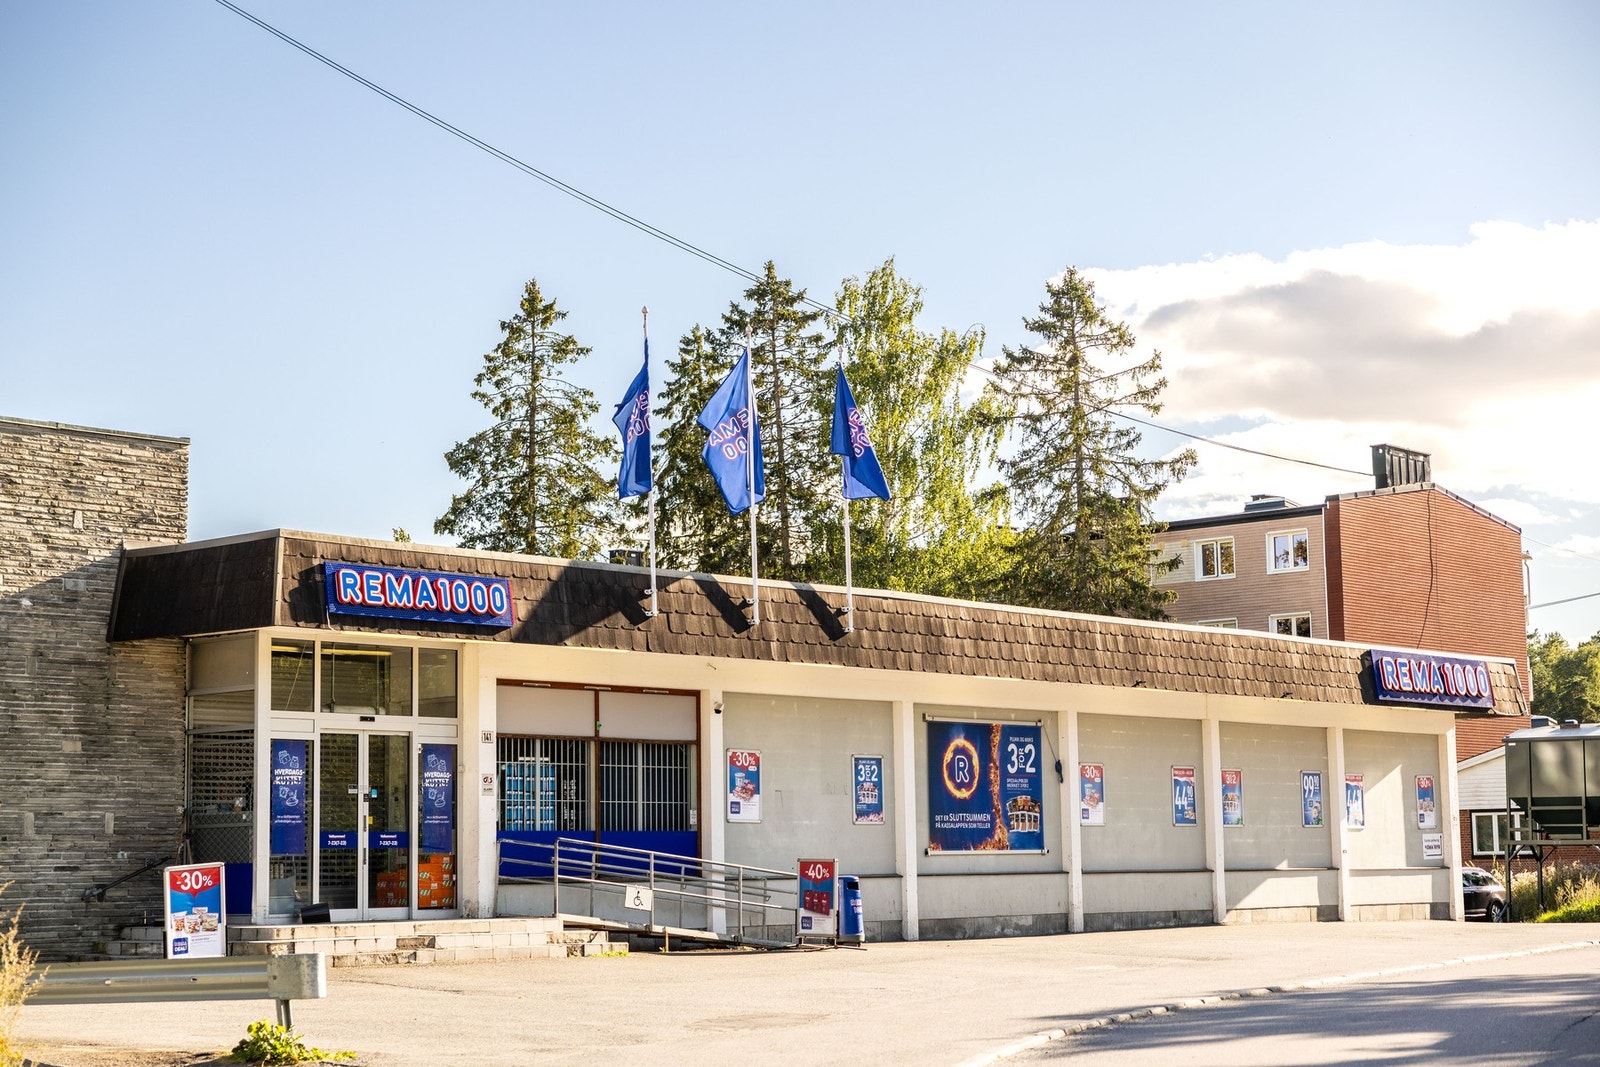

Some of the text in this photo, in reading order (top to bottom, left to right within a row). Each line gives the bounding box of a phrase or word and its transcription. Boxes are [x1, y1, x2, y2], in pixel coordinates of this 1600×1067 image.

[483, 732, 492, 742] 141
[733, 752, 756, 767] -30%
[1007, 743, 1036, 774] 3 FOR 2
[274, 768, 305, 777] HVERDAGS-
[424, 771, 452, 779] HVERDAGS-
[857, 764, 866, 781] 3
[870, 765, 879, 782] 2
[955, 755, 970, 783] R
[1303, 775, 1315, 799] 99
[1175, 785, 1188, 810] 44
[949, 813, 991, 821] SLUTTSUMMEN
[805, 863, 830, 879] -40%
[176, 870, 213, 891] -30%
